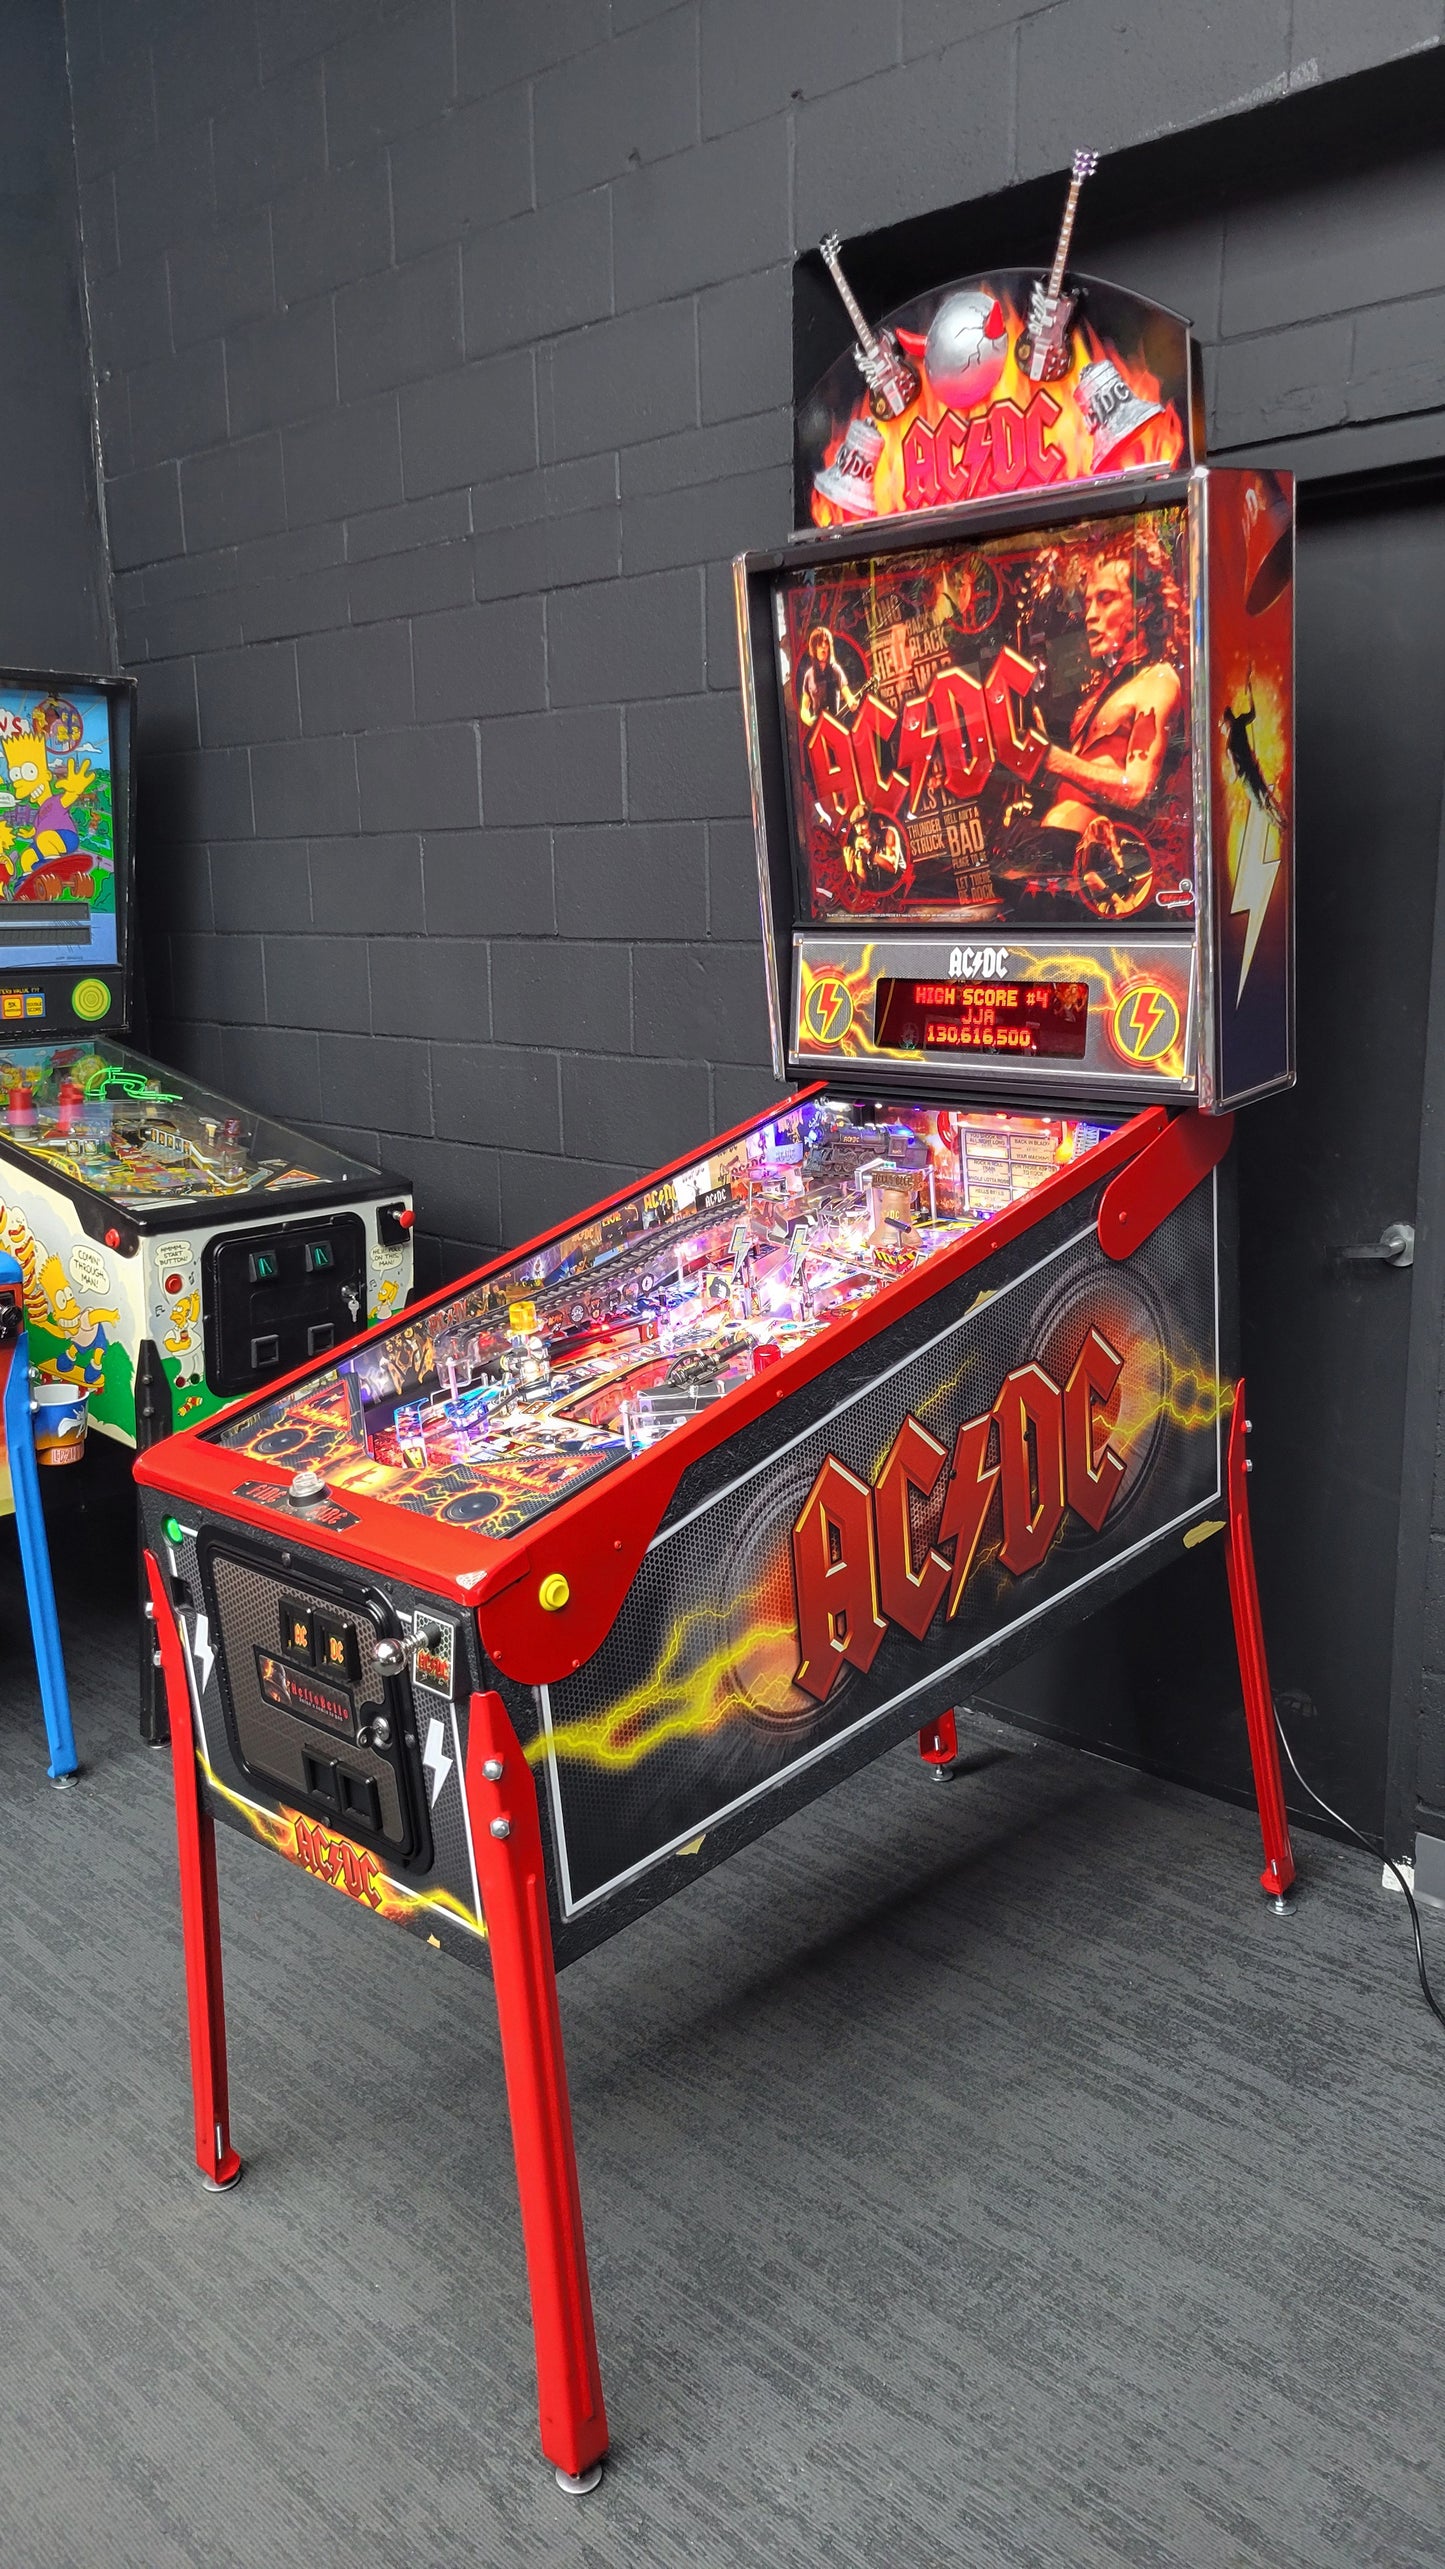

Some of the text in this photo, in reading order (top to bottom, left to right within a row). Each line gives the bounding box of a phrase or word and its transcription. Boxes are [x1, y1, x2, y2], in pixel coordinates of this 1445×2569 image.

[901, 388, 1066, 509] AC/DC
[908, 626, 949, 658] BLACK
[906, 818, 941, 840] THUNDER
[946, 819, 985, 858] BAD
[909, 833, 945, 856] STRUCK
[948, 946, 1010, 979] AC/DC
[915, 986, 1049, 1009] HIGH SCORE #4
[926, 1025, 1032, 1048] 130,616,500
[704, 1188, 727, 1208] AC/DC
[793, 1324, 1127, 1702] AC/DC
[293, 1623, 308, 1648] AC
[329, 1637, 344, 1664] DC
[294, 1815, 382, 1910] AC/DC
